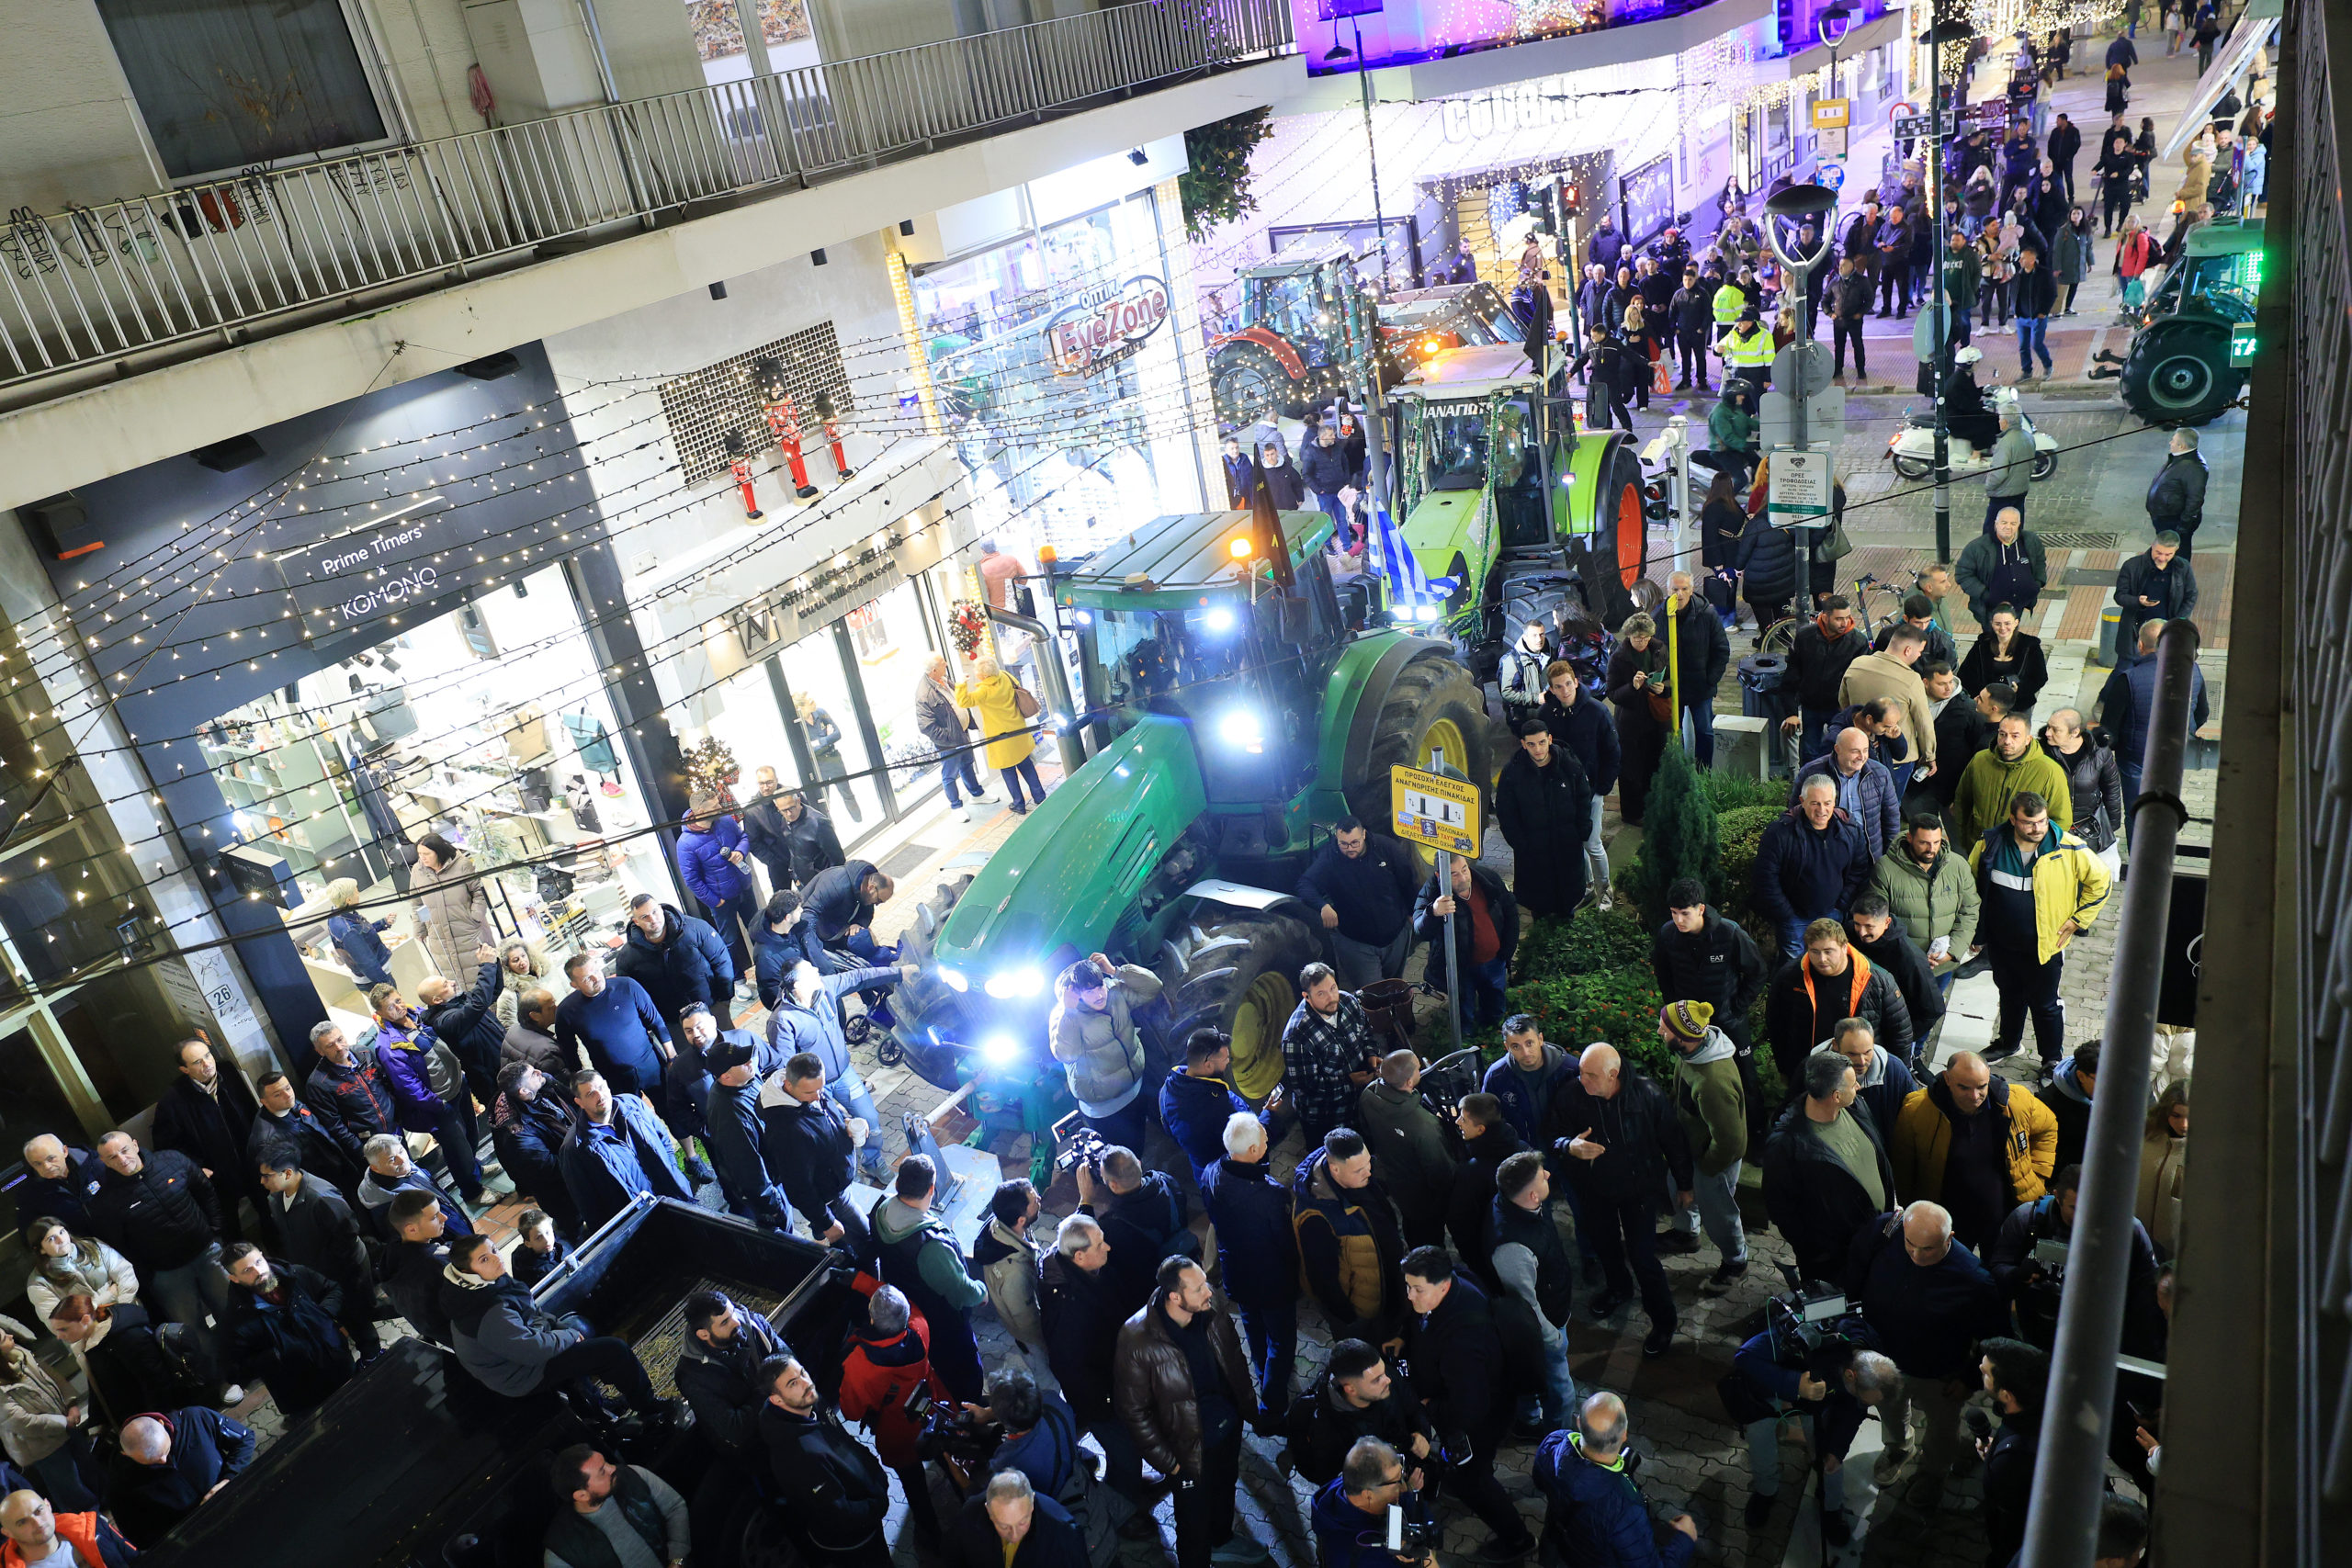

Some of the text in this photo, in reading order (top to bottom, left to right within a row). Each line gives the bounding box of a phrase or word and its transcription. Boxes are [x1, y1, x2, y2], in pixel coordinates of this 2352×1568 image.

[1058, 290, 1169, 367] EyeZone
[322, 526, 424, 576] Prime Timers
[341, 566, 437, 621] KOMONO
[1395, 777, 1476, 805] ΑΝΑΓΝΩΡΙΣΗΣ ΠΙΝΑΚΙΔΑΣ
[1404, 771, 1465, 793] ΠΡΟΣΟΧΗ ΕΛΕΓΧΟΣ
[1710, 954, 1724, 963] EA7
[213, 986, 232, 1007] 26
